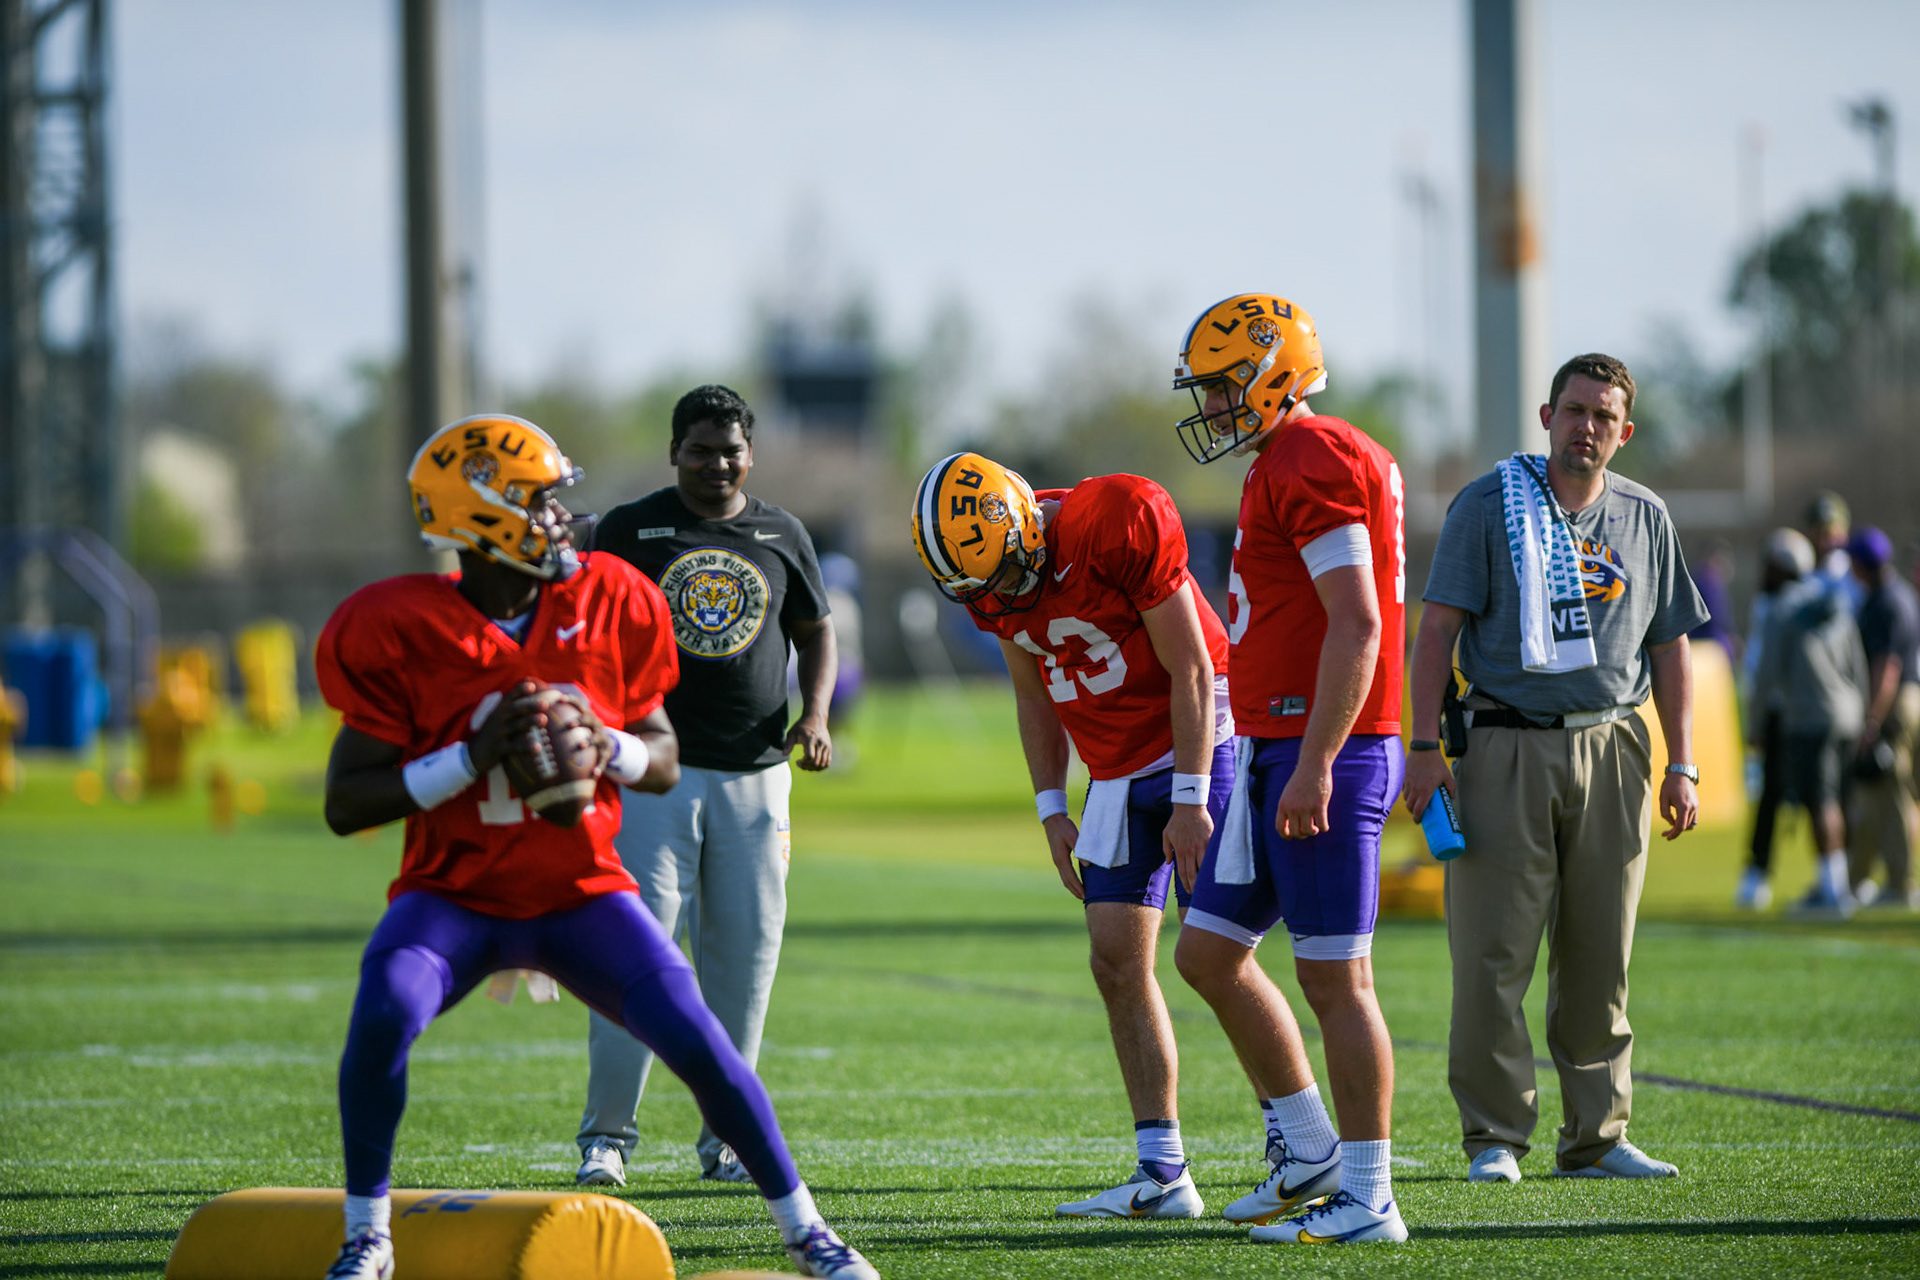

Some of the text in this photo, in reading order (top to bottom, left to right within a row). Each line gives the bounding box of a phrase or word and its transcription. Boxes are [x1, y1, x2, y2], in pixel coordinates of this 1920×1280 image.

[1211, 299, 1293, 336] LSU
[951, 468, 984, 548] LSU
[664, 555, 762, 596] FIGHTING TIGERS
[711, 610, 760, 650] VALLEY
[1013, 616, 1128, 703] 13
